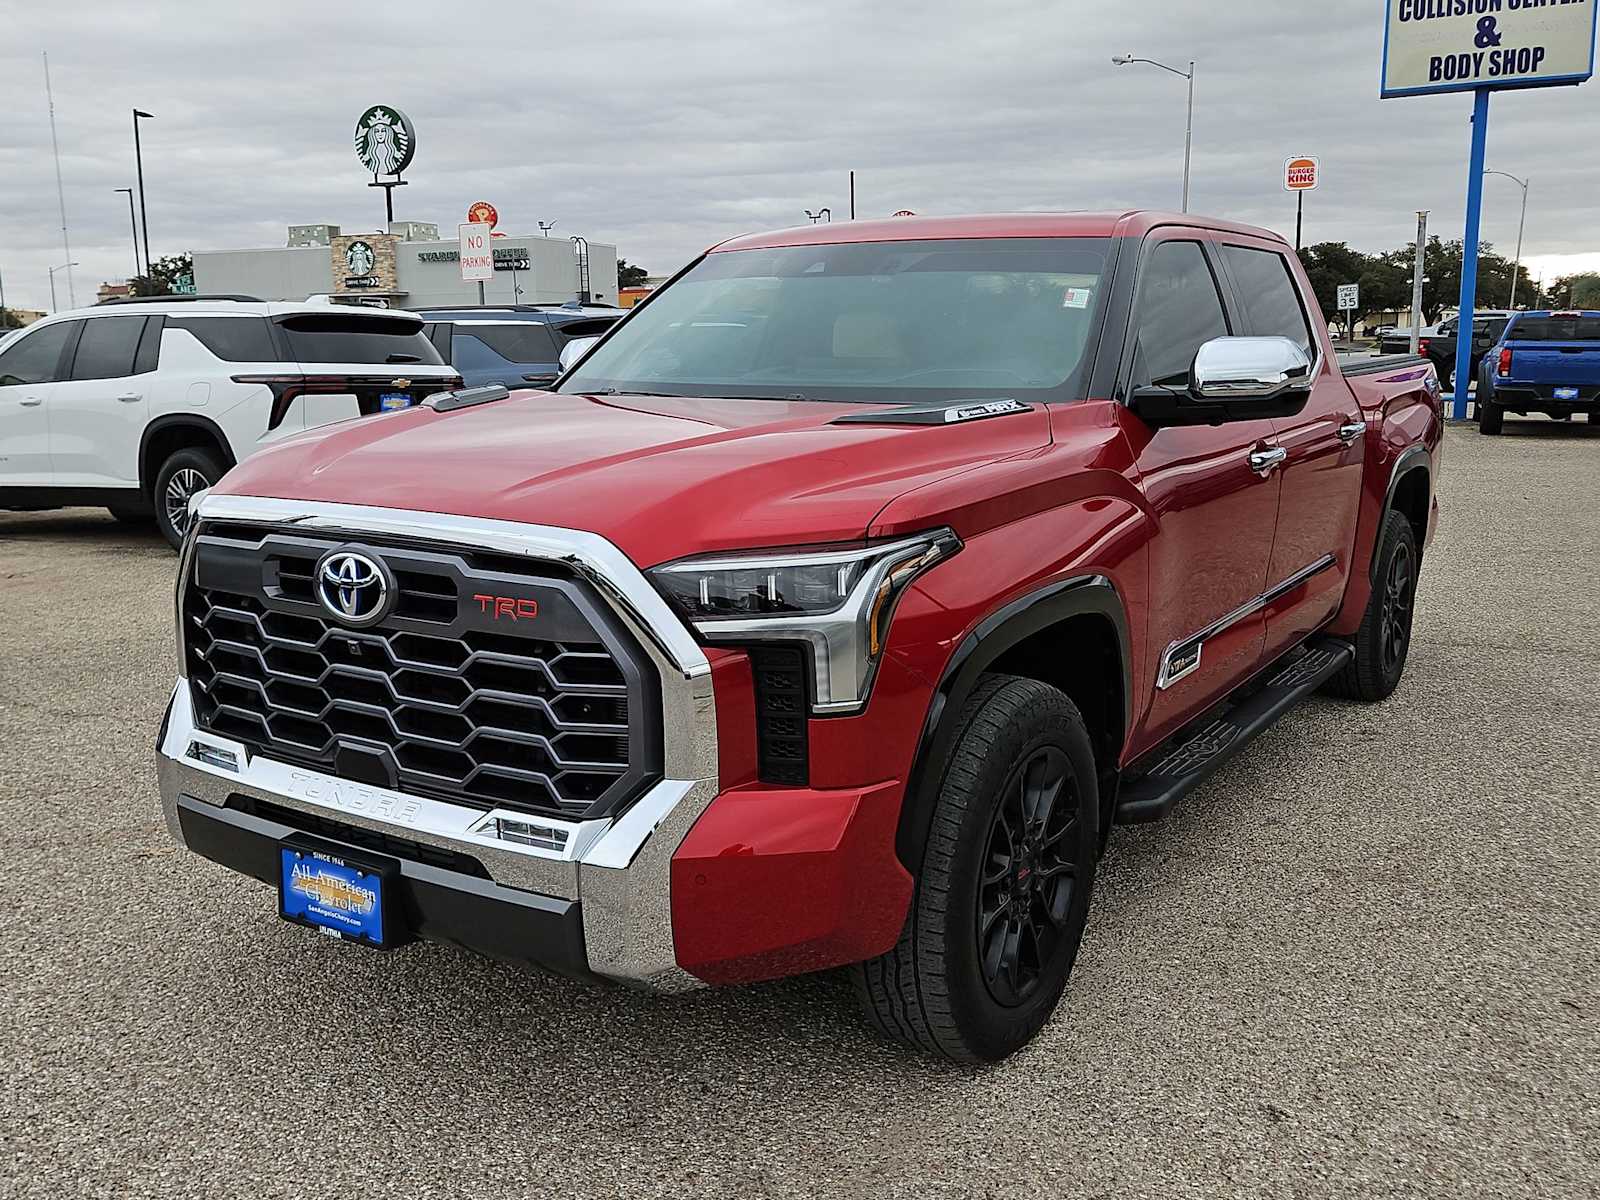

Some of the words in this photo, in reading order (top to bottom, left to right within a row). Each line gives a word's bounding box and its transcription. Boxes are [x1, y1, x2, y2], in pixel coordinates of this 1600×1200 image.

[1474, 15, 1502, 49] &
[1429, 52, 1485, 82] BODY
[1488, 47, 1545, 77] SHOP
[1288, 174, 1315, 183] KING
[468, 236, 483, 248] NO
[462, 256, 491, 269] PARKING
[1340, 298, 1356, 307] 35
[473, 594, 539, 623] TRD
[287, 771, 423, 823] TUNDRA
[313, 851, 331, 863] SINCE
[291, 863, 310, 881] All
[315, 869, 376, 902] American
